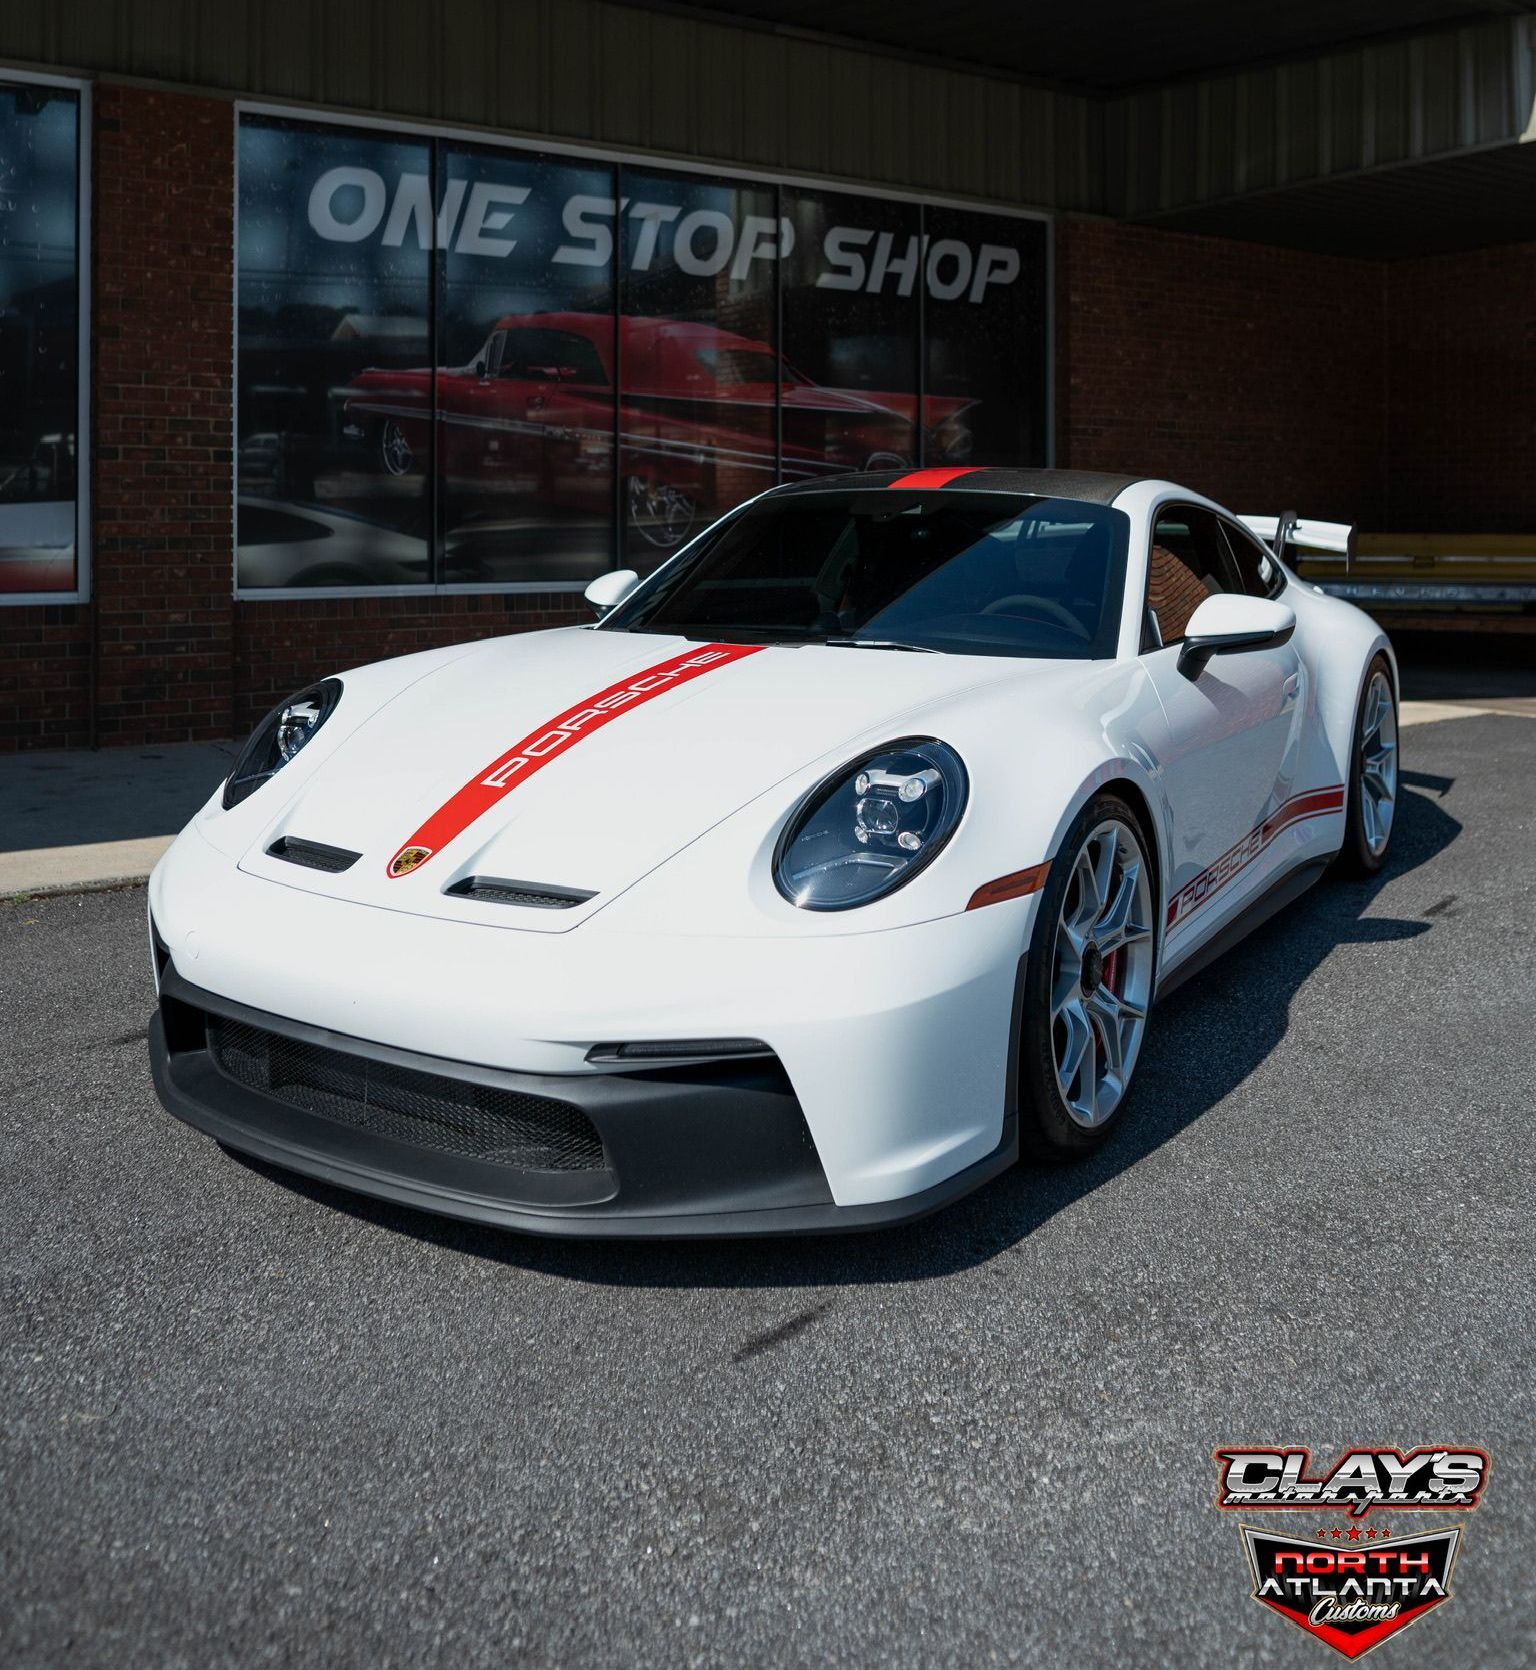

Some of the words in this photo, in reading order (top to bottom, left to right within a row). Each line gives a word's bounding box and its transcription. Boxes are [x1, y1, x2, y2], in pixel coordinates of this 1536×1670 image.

[307, 166, 531, 258] ONE
[552, 194, 795, 281] STOP
[816, 225, 1022, 304] SHOP
[480, 651, 731, 788] PORSCHE
[1179, 829, 1262, 914] PORSCHE
